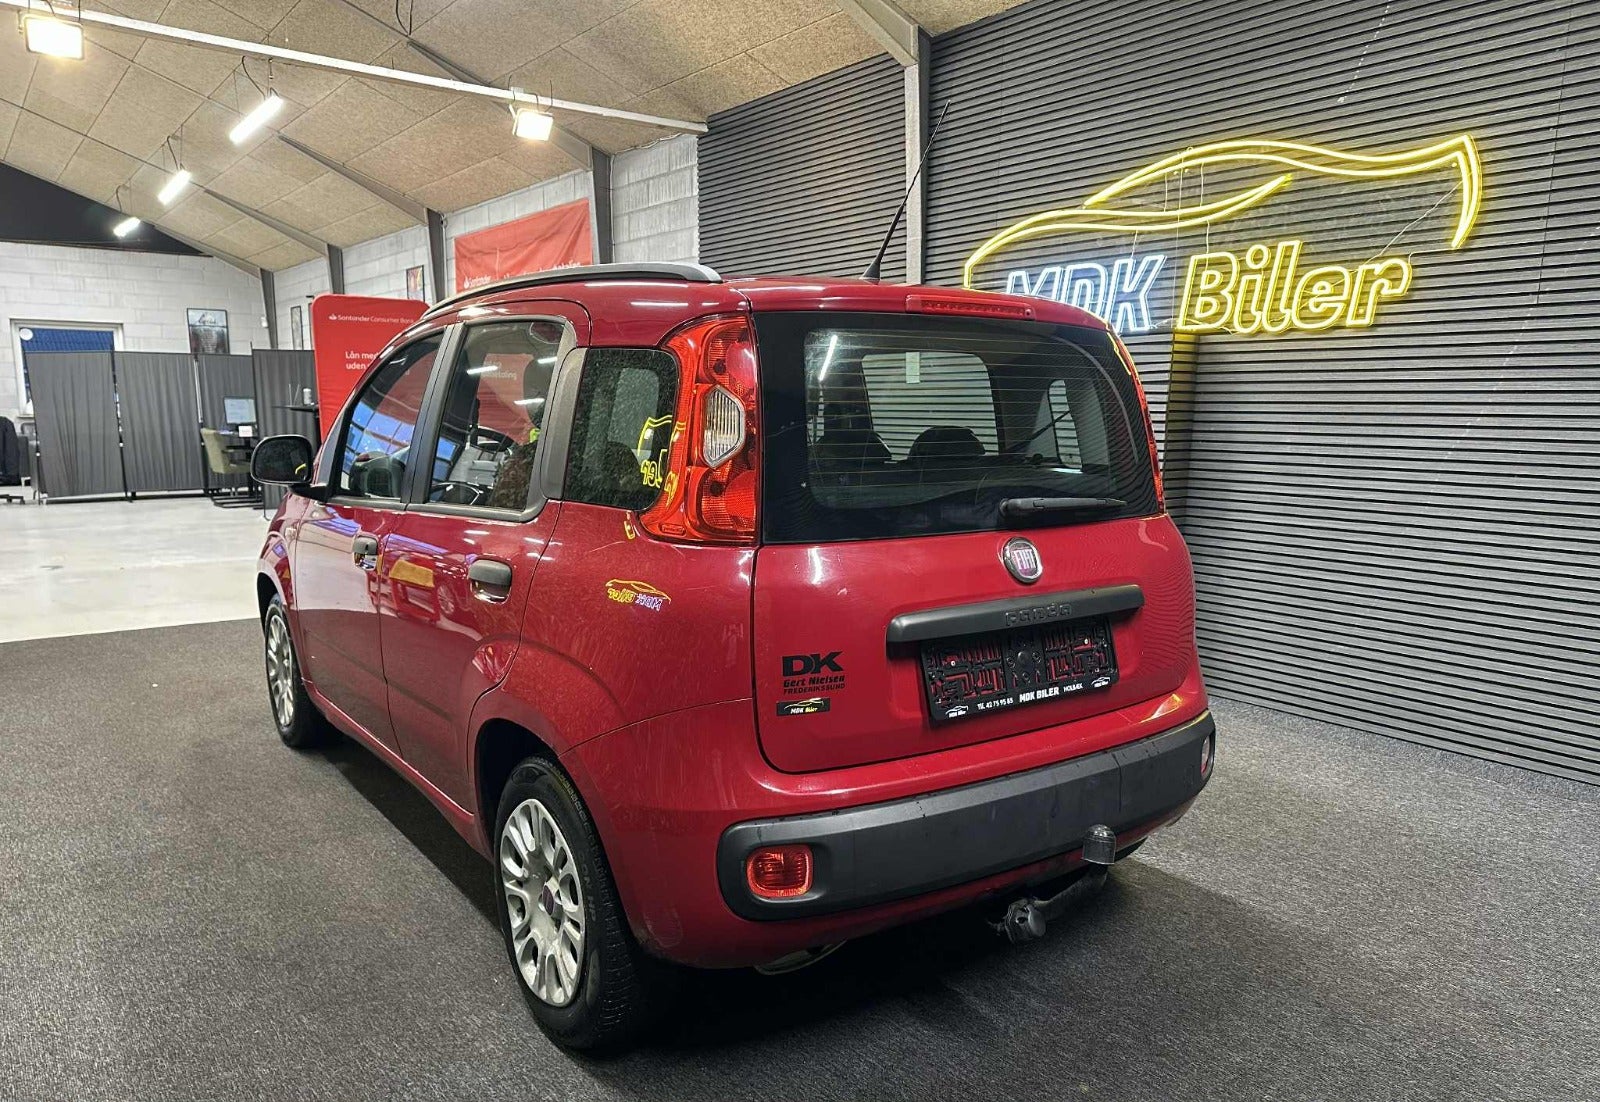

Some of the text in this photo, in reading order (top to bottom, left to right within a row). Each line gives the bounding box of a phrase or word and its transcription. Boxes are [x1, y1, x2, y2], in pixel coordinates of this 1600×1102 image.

[1176, 240, 1413, 335] Biler
[338, 314, 370, 322] Santander
[345, 350, 360, 359] Lån
[346, 362, 366, 370] uden
[1014, 549, 1036, 570] FIAT
[782, 651, 844, 677] DK
[784, 676, 844, 687] Gert Nielsen
[784, 684, 844, 694] FREDERIKSSUND
[1019, 693, 1035, 703] MDK
[1036, 687, 1060, 699] BILER
